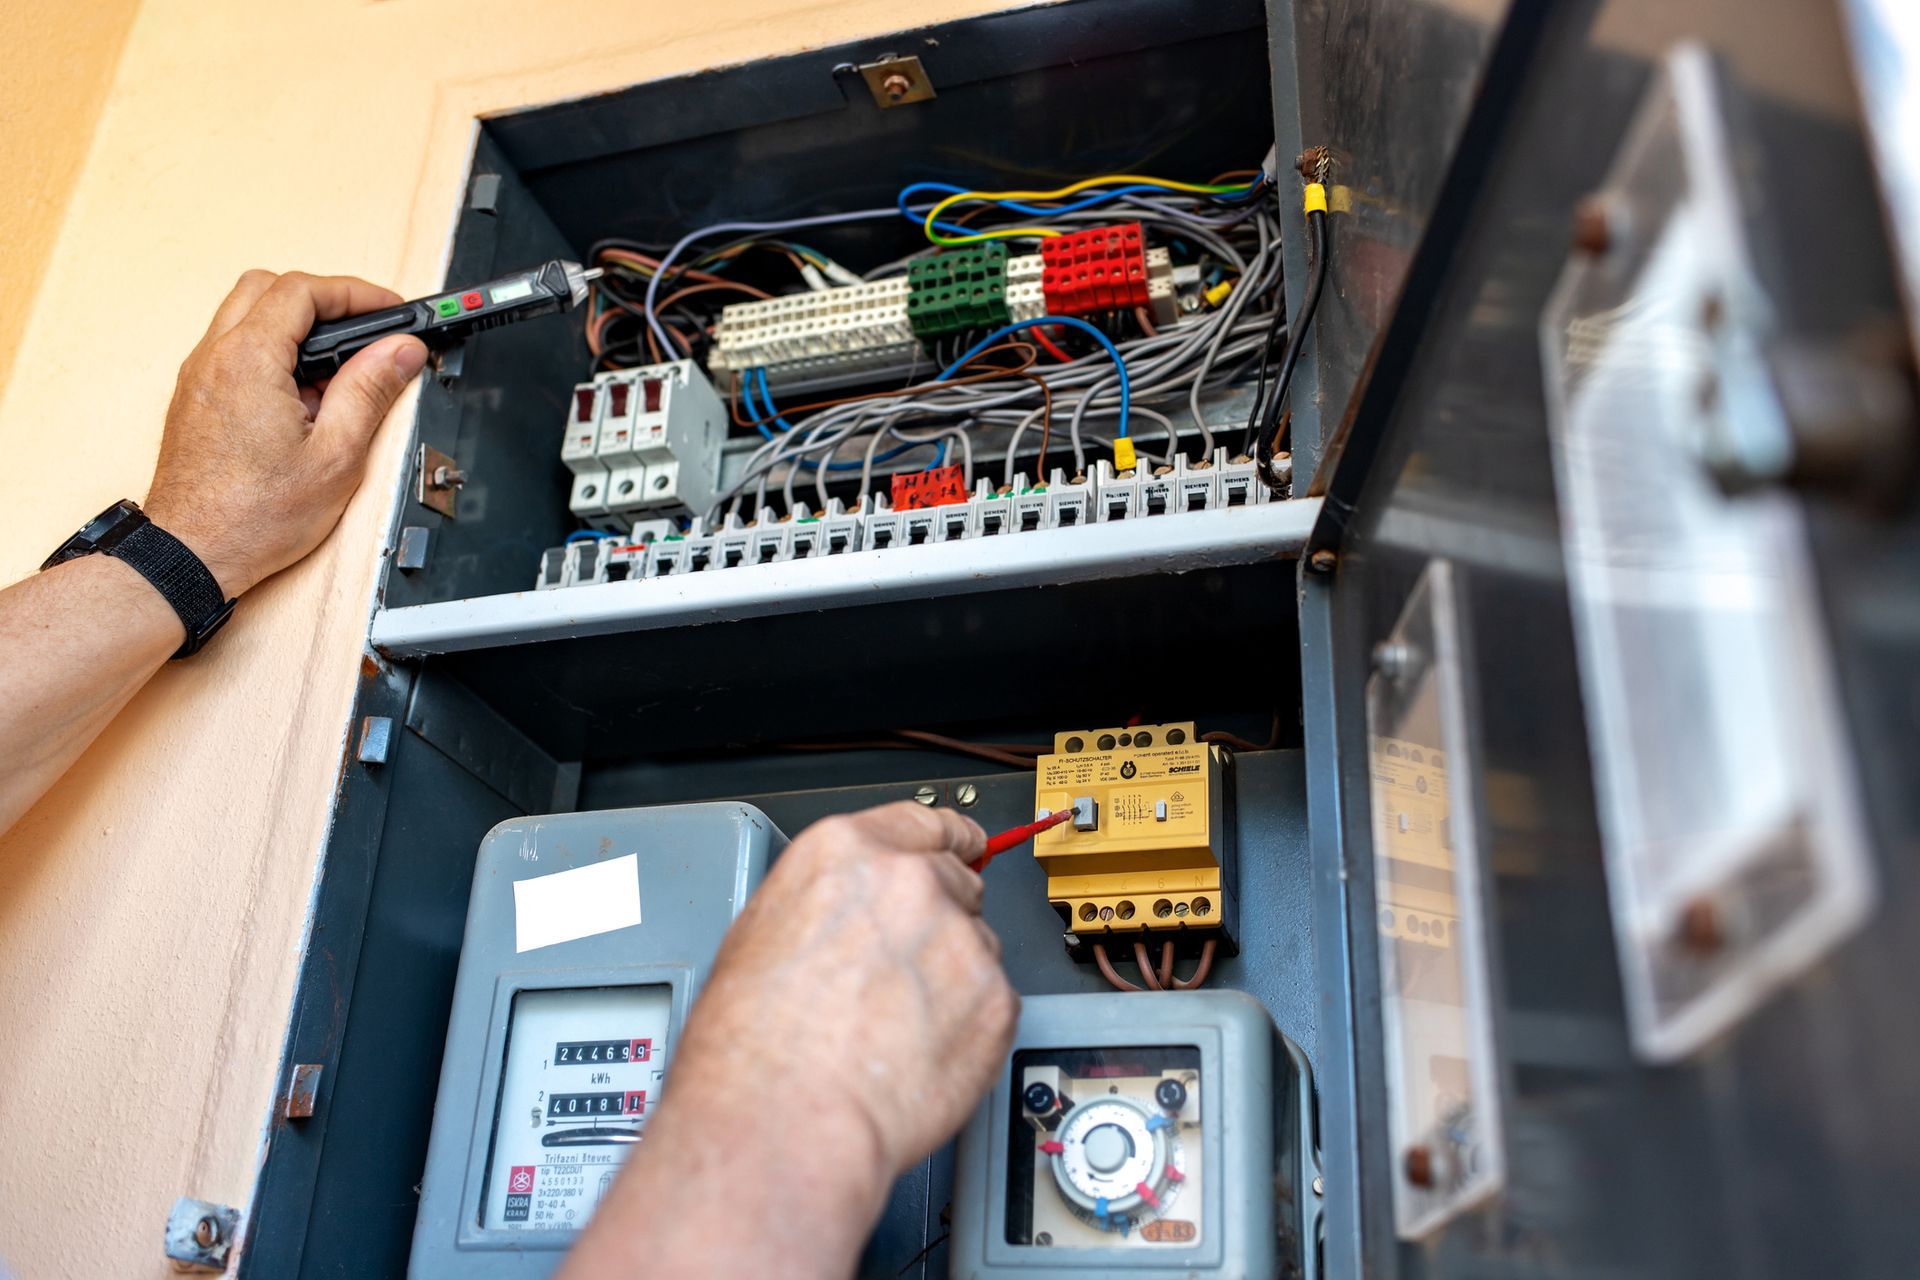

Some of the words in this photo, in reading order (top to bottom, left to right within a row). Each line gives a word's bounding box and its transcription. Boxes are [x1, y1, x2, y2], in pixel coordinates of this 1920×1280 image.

[1169, 765, 1200, 773] SCHIELE
[1195, 875, 1204, 887] N
[544, 1060, 547, 1070] 1
[591, 1072, 611, 1084] kWh
[539, 1090, 544, 1102] 2
[545, 1154, 578, 1163] Trifazni
[578, 1188, 584, 1196] V
[537, 1200, 558, 1208] 10-40
[560, 1200, 566, 1208] A
[535, 1211, 544, 1219] 50
